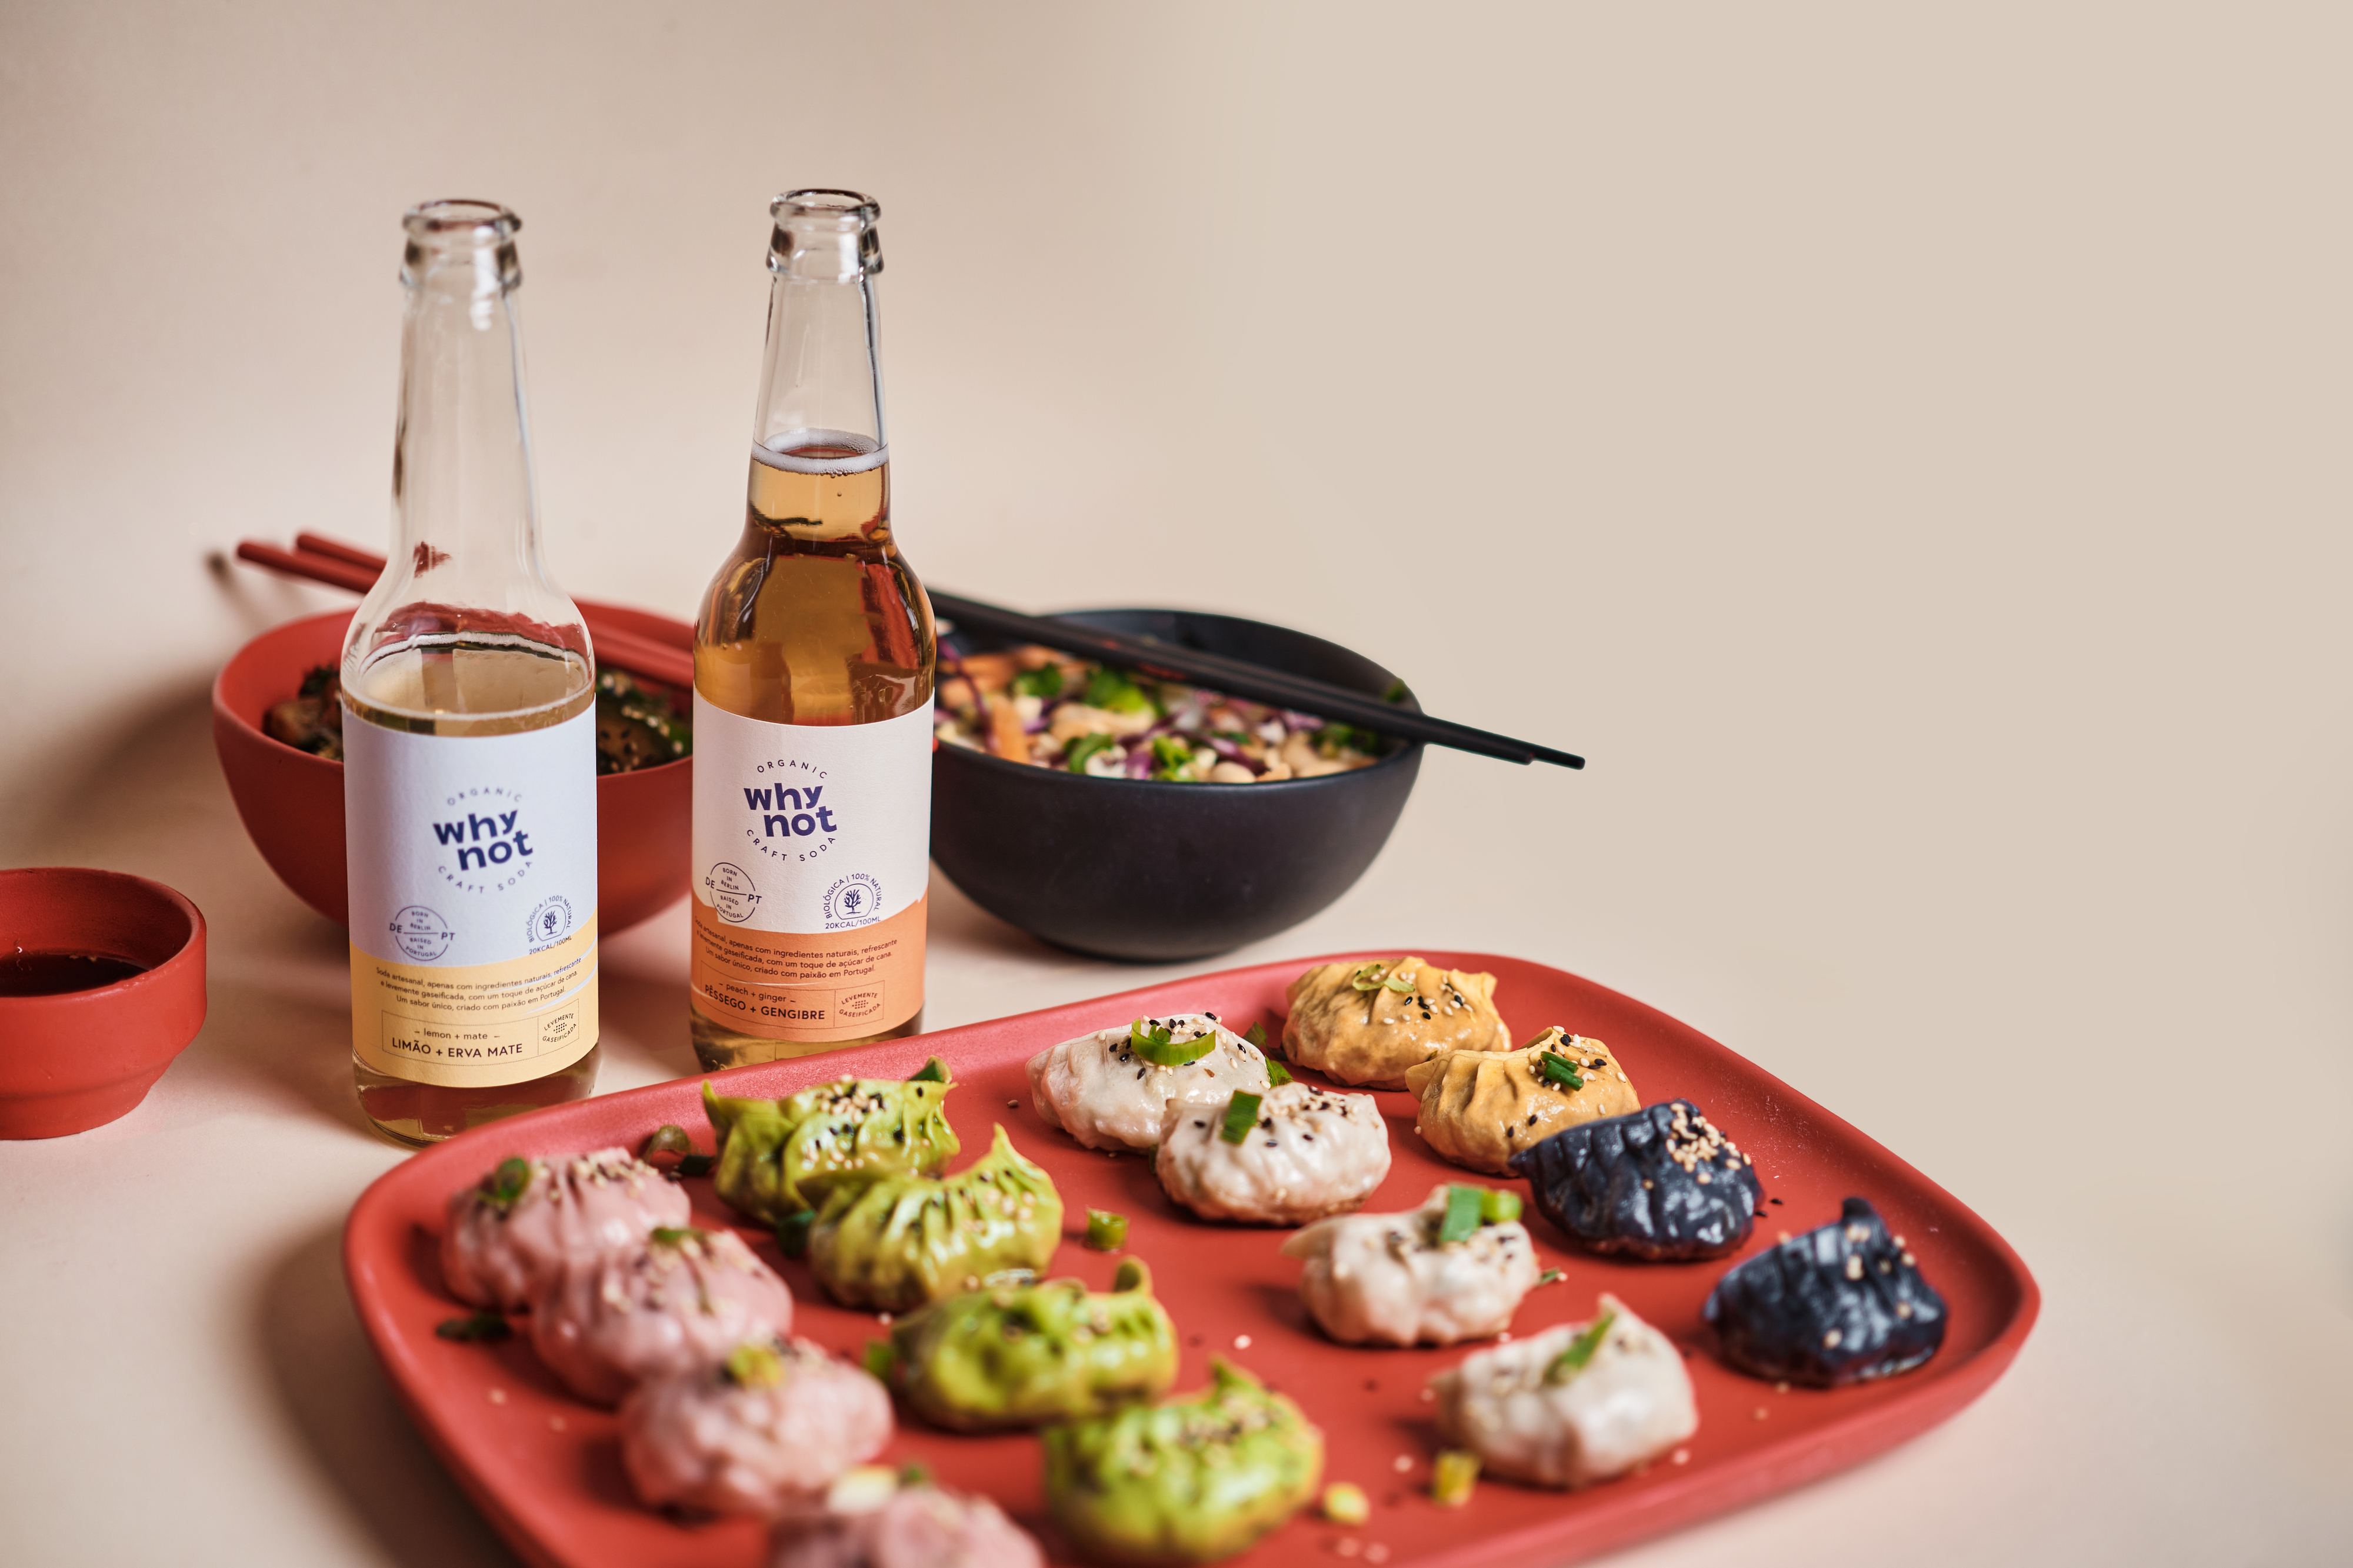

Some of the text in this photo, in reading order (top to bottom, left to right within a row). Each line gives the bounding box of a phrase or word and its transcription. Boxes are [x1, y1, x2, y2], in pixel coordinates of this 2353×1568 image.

[758, 760, 827, 778] ORGANIC
[447, 787, 522, 805] ORGANIC
[744, 783, 824, 810] why
[433, 810, 518, 845] why
[764, 806, 837, 837] not
[458, 830, 533, 870] not
[747, 829, 835, 861] CRAFT SODA
[438, 862, 532, 893] CRAFT SODA
[723, 868, 738, 876] BORN
[706, 876, 715, 889] DE
[721, 880, 739, 890] BERLIN
[720, 895, 739, 905] RAISED
[748, 894, 762, 904] PT
[823, 879, 845, 919] BIOLÓGICA
[871, 878, 881, 910] NATURAL
[716, 904, 744, 918] PORTUGAL
[389, 923, 402, 933] DE
[526, 903, 544, 943] BIOLÓGICA
[564, 899, 572, 929] NATURAL
[825, 916, 881, 929] 20KCAL/100ML
[441, 932, 455, 940] PT
[529, 935, 572, 955] 20KCAL/100ML
[704, 926, 727, 945] artesanal,
[729, 940, 753, 950] apenas
[774, 949, 824, 958] ingredientes
[826, 949, 859, 958] naturais,
[861, 940, 898, 954] refrescante
[406, 946, 436, 956] PORTUGAL
[724, 948, 764, 965] gaseificada,
[839, 959, 864, 968] açúcar
[876, 952, 892, 960] cana.
[706, 946, 714, 956] Um
[715, 953, 731, 963] sabor
[732, 959, 752, 972] único,
[755, 967, 778, 975] criado
[800, 970, 826, 979] paixão
[844, 965, 875, 976] Portugal.
[376, 967, 390, 978] Soda
[392, 975, 425, 987] artesanal,
[475, 981, 522, 990] ingredientes
[525, 973, 552, 983] naturais,
[554, 958, 581, 975] refrescante
[386, 981, 419, 995] levemente
[422, 991, 466, 1001] gaseificada,
[502, 990, 522, 999] toque
[536, 981, 555, 992] açúcar
[566, 971, 578, 980] cana.
[726, 984, 748, 996] peach
[759, 993, 786, 1002] ginger
[396, 995, 407, 1003] Um
[432, 1002, 454, 1011] único,
[502, 1000, 526, 1010] paixão
[540, 986, 565, 1001] Portugal.
[705, 985, 746, 1010] PÊSSEGO
[761, 1006, 825, 1019] GENGIBRE
[841, 993, 878, 1005] LEVEMENTE
[839, 1003, 881, 1017] GASEIFICADA
[544, 1013, 574, 1030] LEVEMENTE
[424, 1028, 451, 1039] lemon
[542, 1023, 576, 1042] GASEIFICADA
[392, 1037, 431, 1054] LIMÃO
[448, 1048, 482, 1057] ERVA
[488, 1043, 522, 1056] MATE
